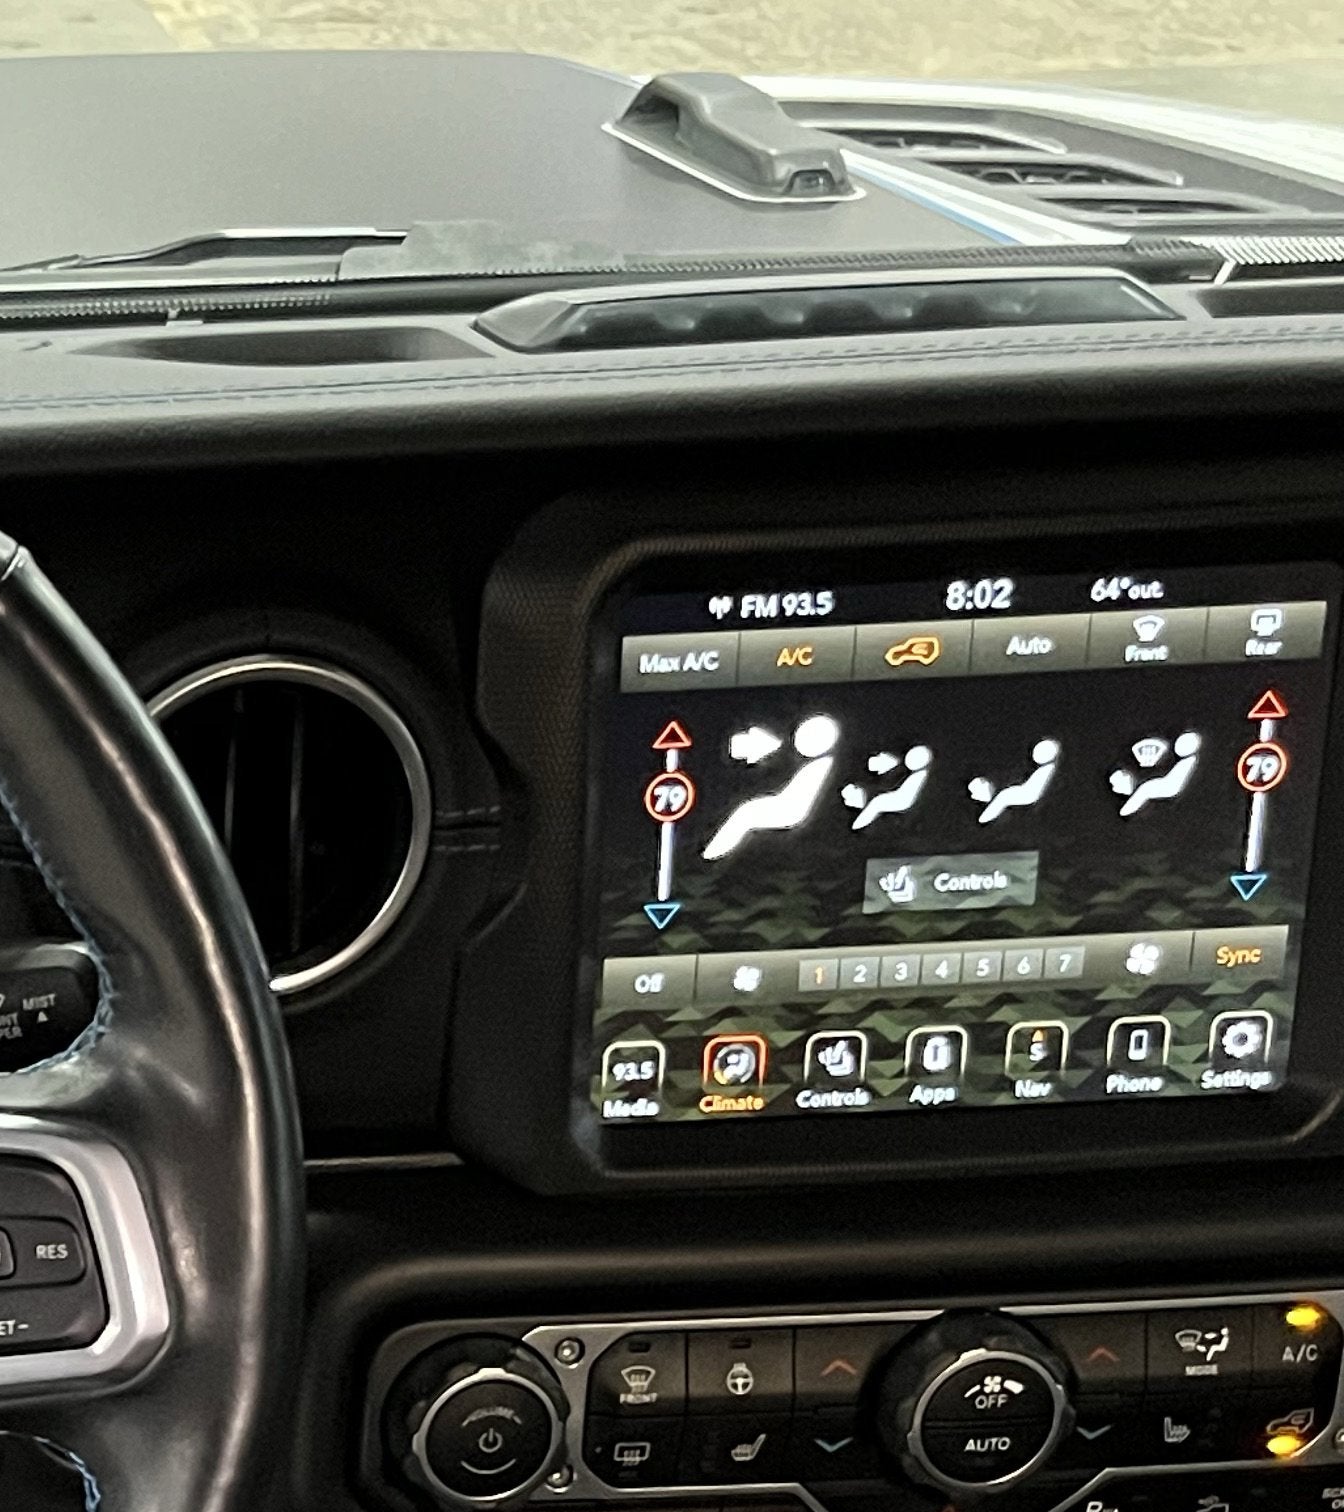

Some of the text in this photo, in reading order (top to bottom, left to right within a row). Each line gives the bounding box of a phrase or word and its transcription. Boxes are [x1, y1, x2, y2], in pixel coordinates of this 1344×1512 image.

[946, 577, 1014, 611] 8:02
[740, 591, 835, 618] FM 93.5
[1006, 636, 1054, 656] Auto
[1124, 645, 1169, 662] Front
[1246, 639, 1284, 656] Rear
[640, 651, 720, 674] Max A/C
[777, 647, 814, 667] A/C
[1246, 757, 1279, 782] 79
[653, 786, 685, 811] 79
[934, 870, 1009, 893] Controls
[977, 957, 990, 976] 5
[1018, 955, 1031, 975] 6
[1059, 954, 1073, 973] 7
[1216, 945, 1263, 968] Sync
[814, 966, 823, 985] 1
[854, 964, 868, 983] 2
[895, 962, 909, 981] 3
[935, 958, 949, 978] 4
[634, 972, 665, 993] Off
[22, 993, 57, 1011] MIST
[612, 1061, 655, 1081] 93.5
[1201, 1069, 1273, 1091] Settings
[909, 1084, 957, 1104] Apps
[1014, 1080, 1053, 1099] Nav
[1106, 1074, 1165, 1094] Phone
[603, 1098, 660, 1118] Media
[700, 1095, 766, 1114] Climate
[796, 1087, 872, 1110] Controls
[36, 1245, 69, 1261] RES
[1282, 1345, 1319, 1363] A/C
[975, 1394, 1009, 1410] OFF
[964, 1436, 1011, 1452] AUTO
